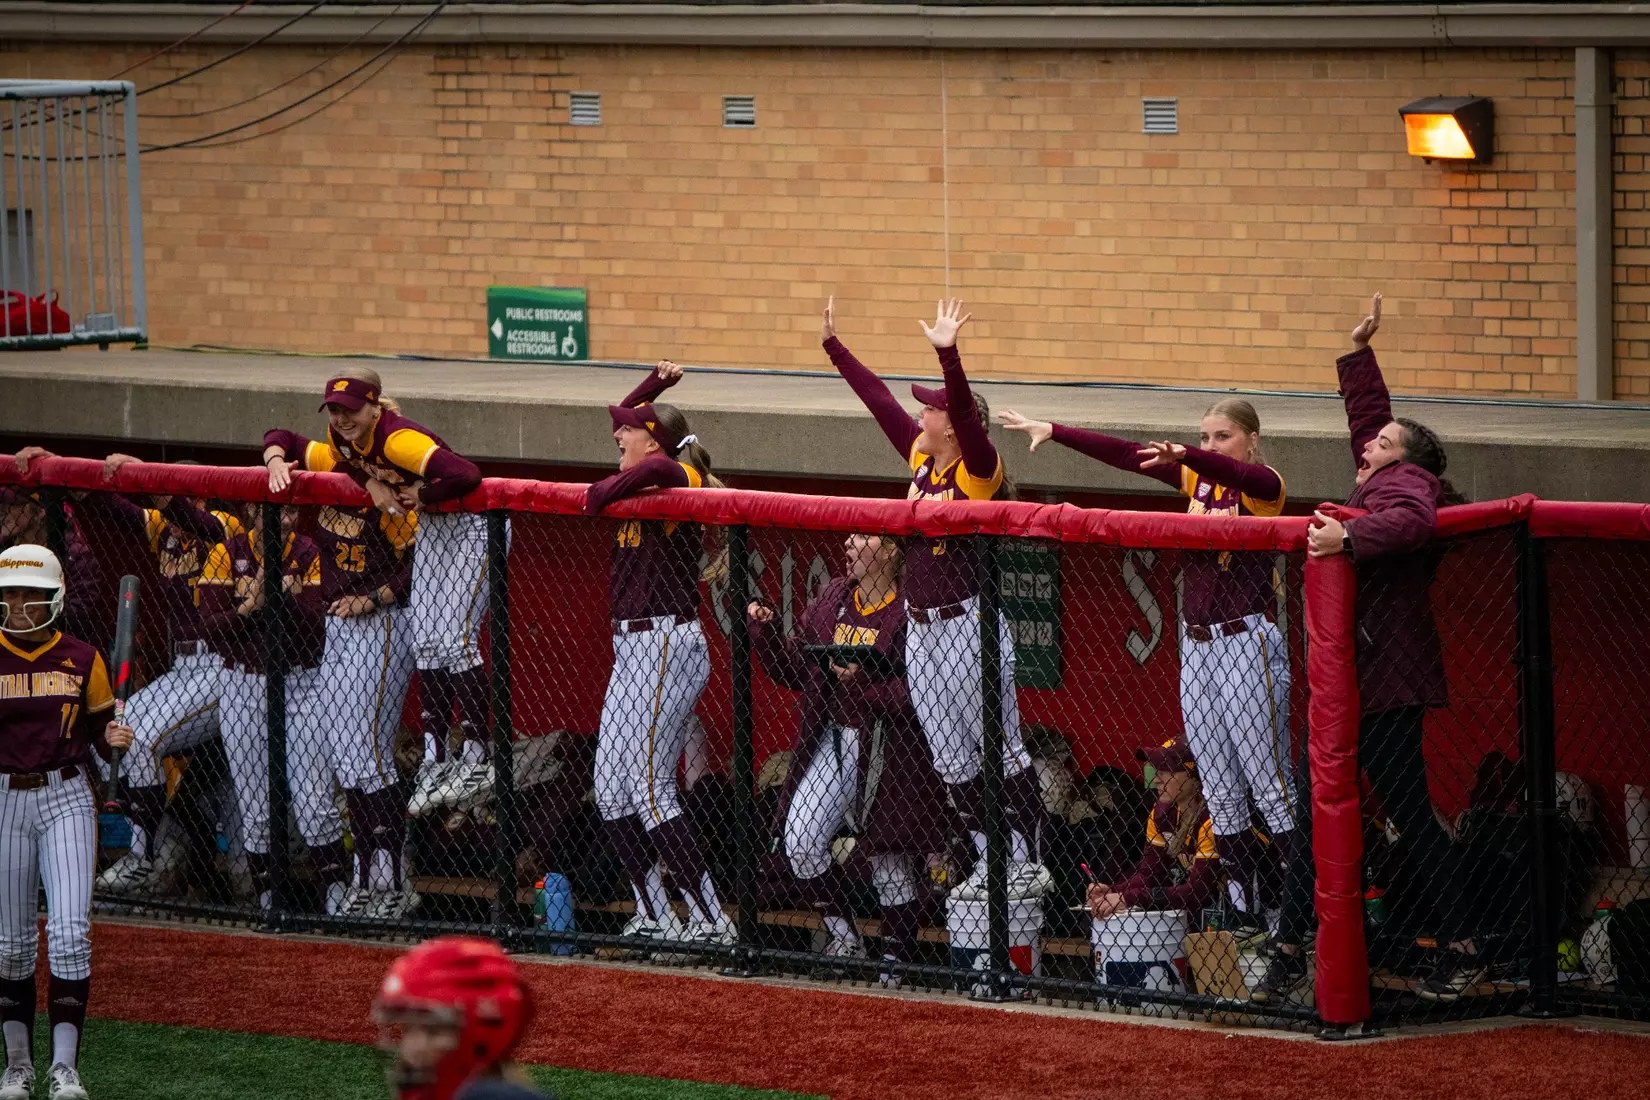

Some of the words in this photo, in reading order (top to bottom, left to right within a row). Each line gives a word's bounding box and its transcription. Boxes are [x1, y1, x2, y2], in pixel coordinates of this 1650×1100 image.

[506, 307, 533, 319] PUBLIC
[535, 309, 583, 321] RESTROOMS
[507, 330, 556, 342] ACCESSIBLE
[507, 343, 557, 355] RESTROOMS
[335, 541, 366, 572] 25
[0, 673, 30, 699] TRAL
[59, 703, 79, 738] 11
